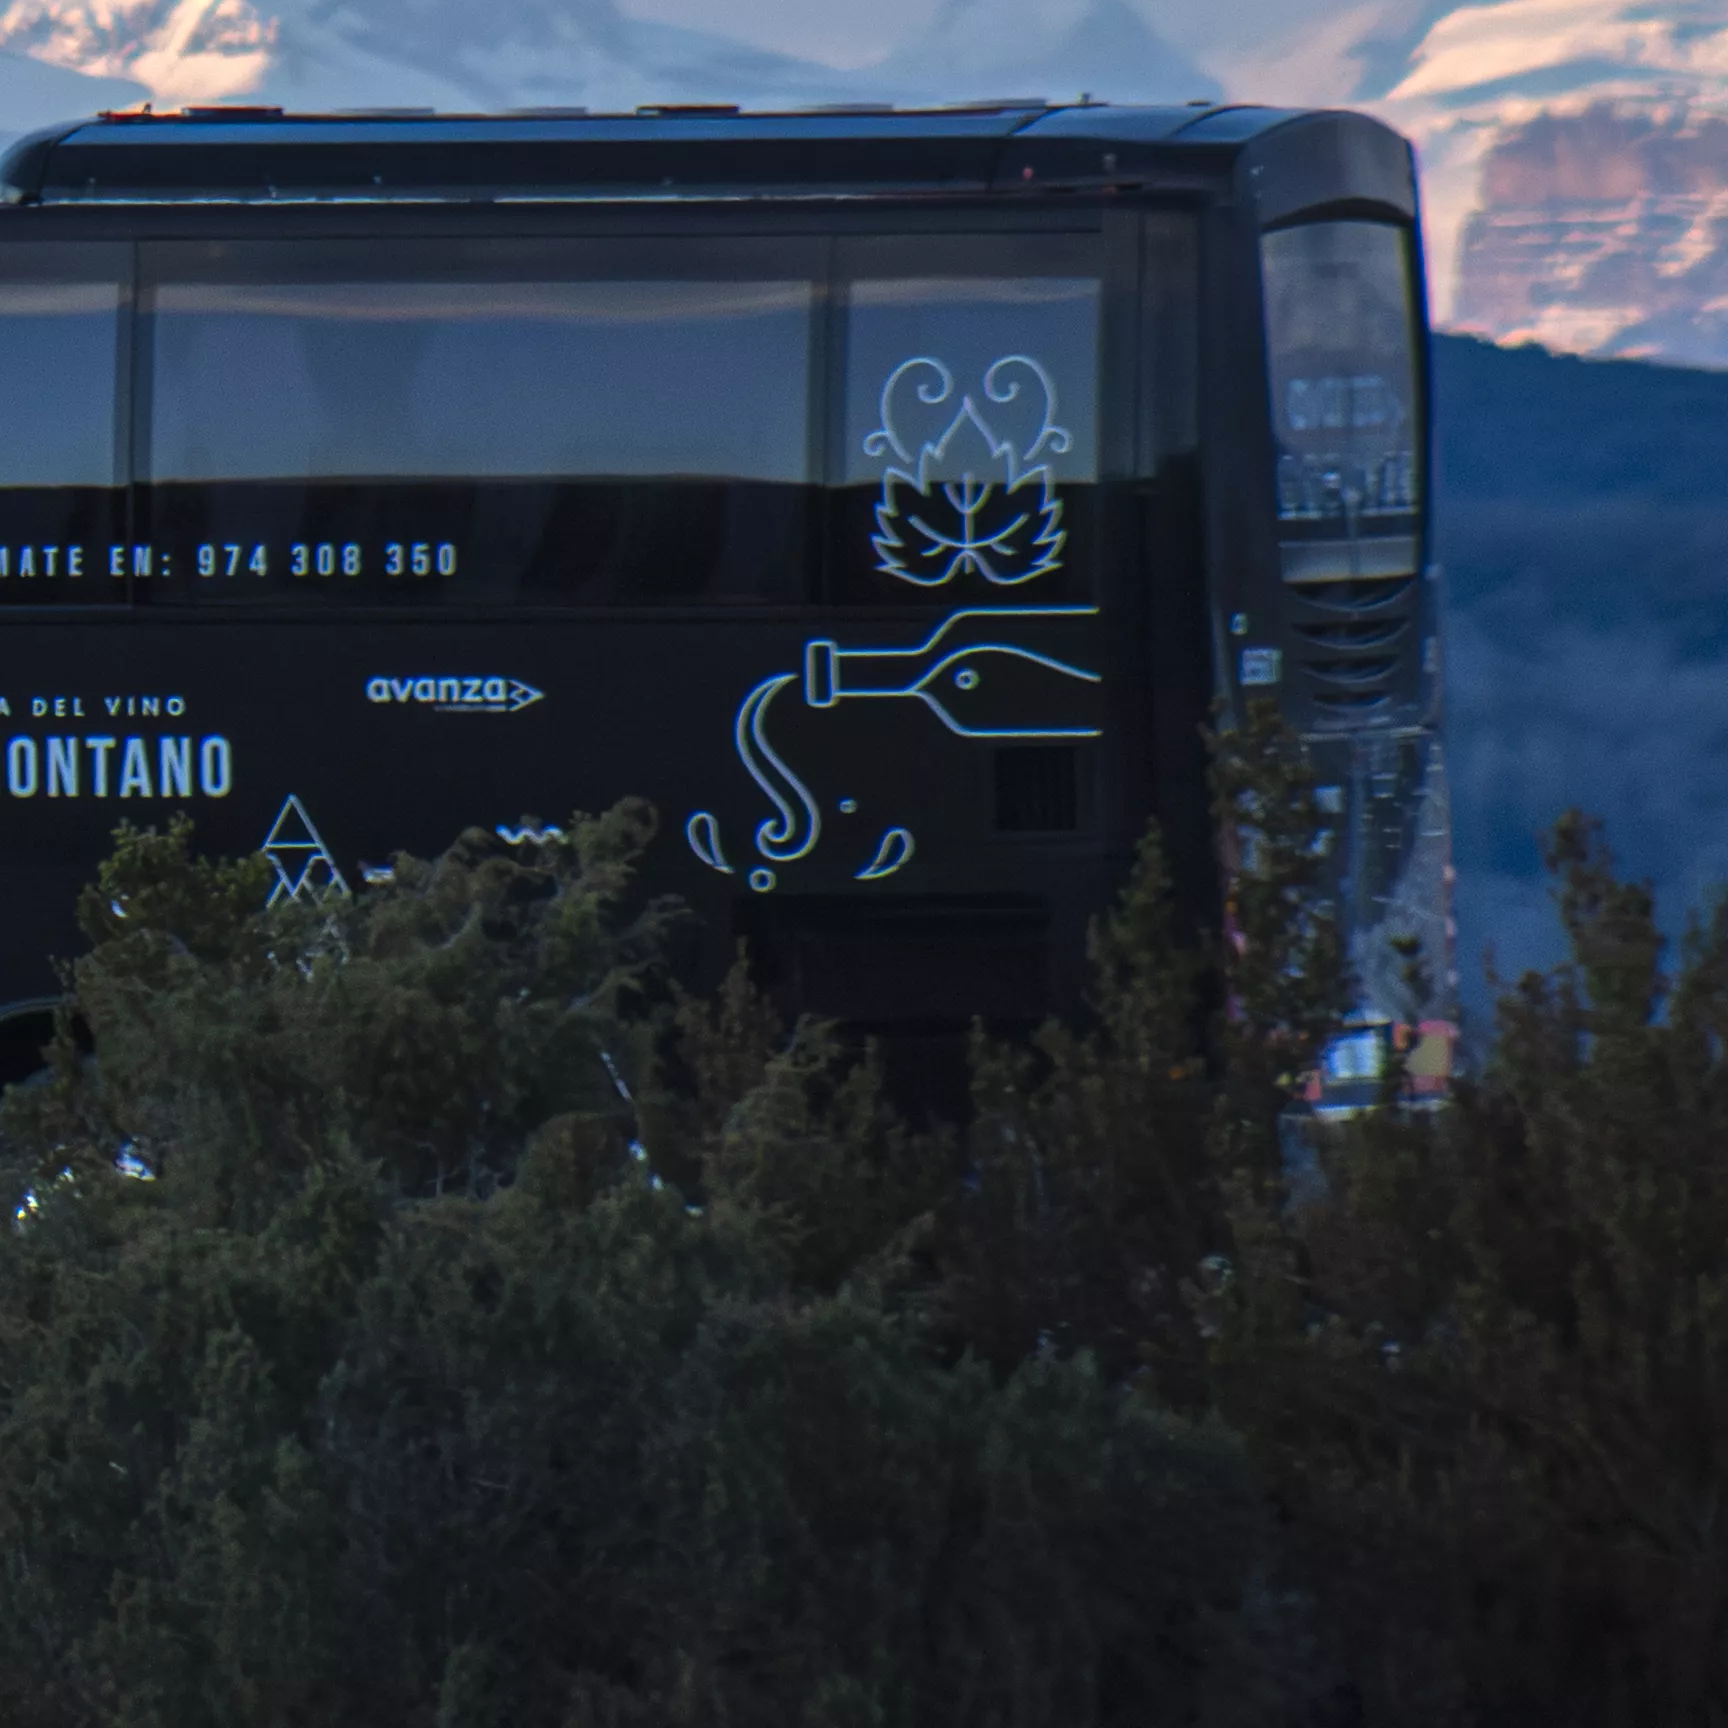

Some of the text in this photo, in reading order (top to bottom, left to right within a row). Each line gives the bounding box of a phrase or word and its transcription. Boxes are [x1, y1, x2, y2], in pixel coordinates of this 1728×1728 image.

[109, 545, 168, 575] EN:
[198, 544, 265, 575] 974
[292, 543, 358, 574] 308
[386, 543, 452, 574] 350
[366, 675, 507, 703] avanza
[32, 697, 82, 716] DEL
[105, 696, 183, 715] VINO
